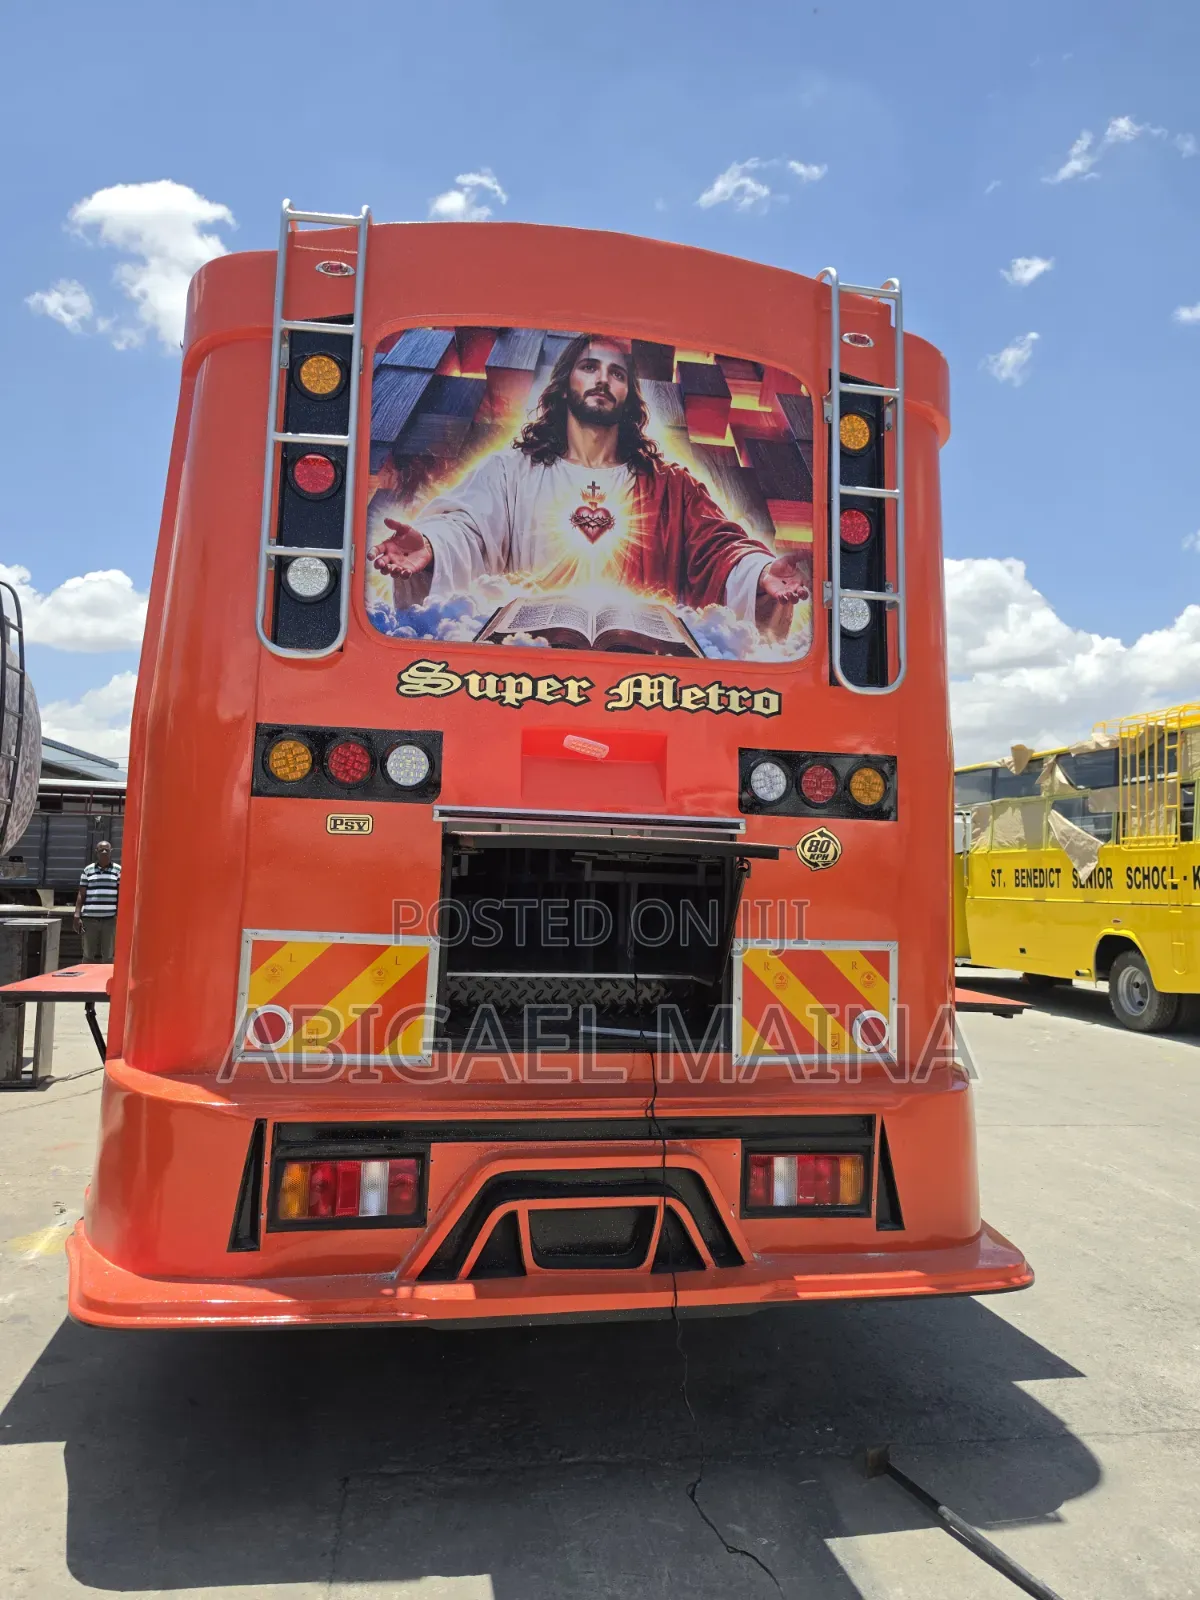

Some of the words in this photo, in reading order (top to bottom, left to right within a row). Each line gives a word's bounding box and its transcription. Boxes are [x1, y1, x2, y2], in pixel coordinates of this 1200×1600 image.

[398, 659, 594, 708] Super
[605, 673, 781, 717] Metro
[807, 840, 831, 853] 80
[991, 869, 1006, 888] ST.
[1014, 867, 1061, 888] BENEDICT
[763, 962, 772, 971] R
[851, 961, 858, 970] R
